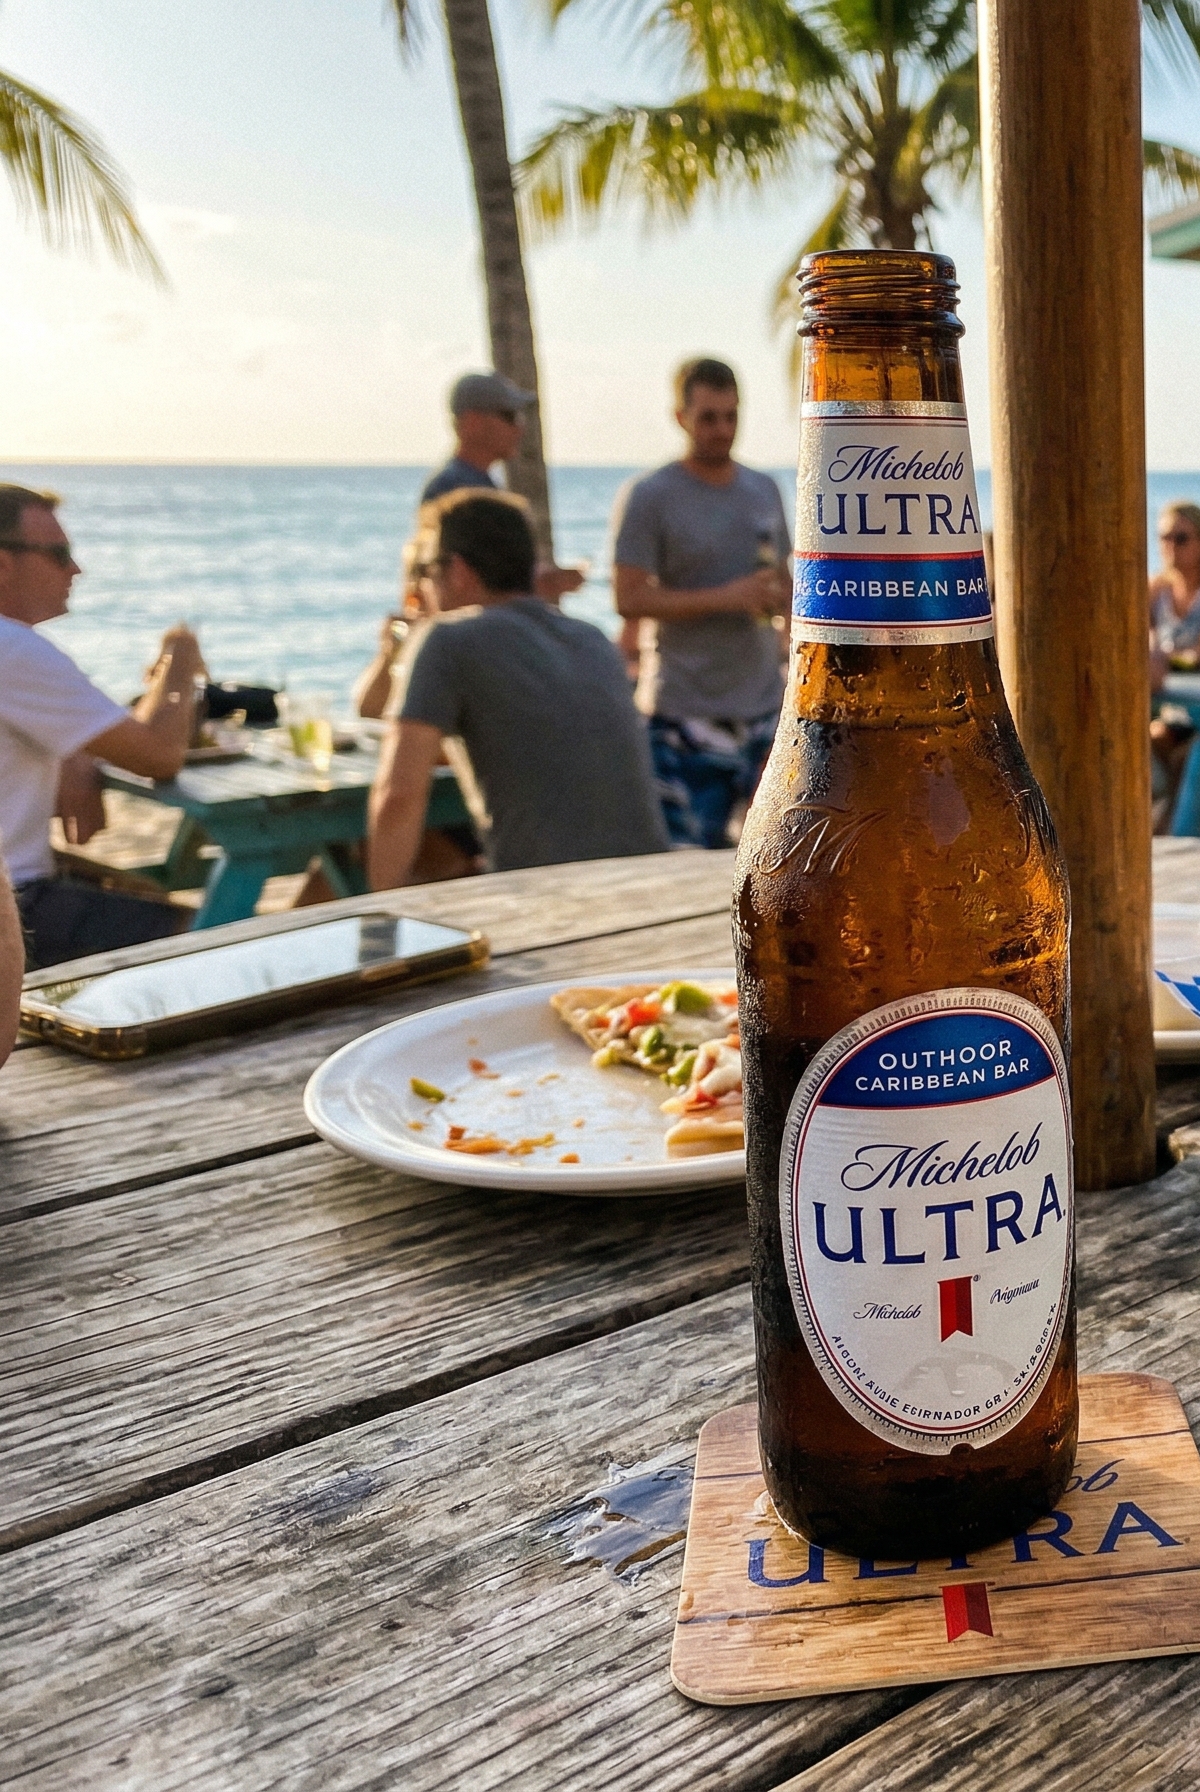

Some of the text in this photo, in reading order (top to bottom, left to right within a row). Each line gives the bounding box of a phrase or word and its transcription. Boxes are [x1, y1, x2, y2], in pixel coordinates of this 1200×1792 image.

[827, 445, 965, 483] Michelob
[816, 493, 979, 535] ULTRA
[815, 579, 984, 598] CARIBBEAN BAR
[878, 1039, 1012, 1070] OUTHOOR
[855, 1058, 1030, 1092] CARIBBEAN BAR
[840, 1121, 1044, 1192] Michelob
[811, 1172, 1064, 1265] ULTRA
